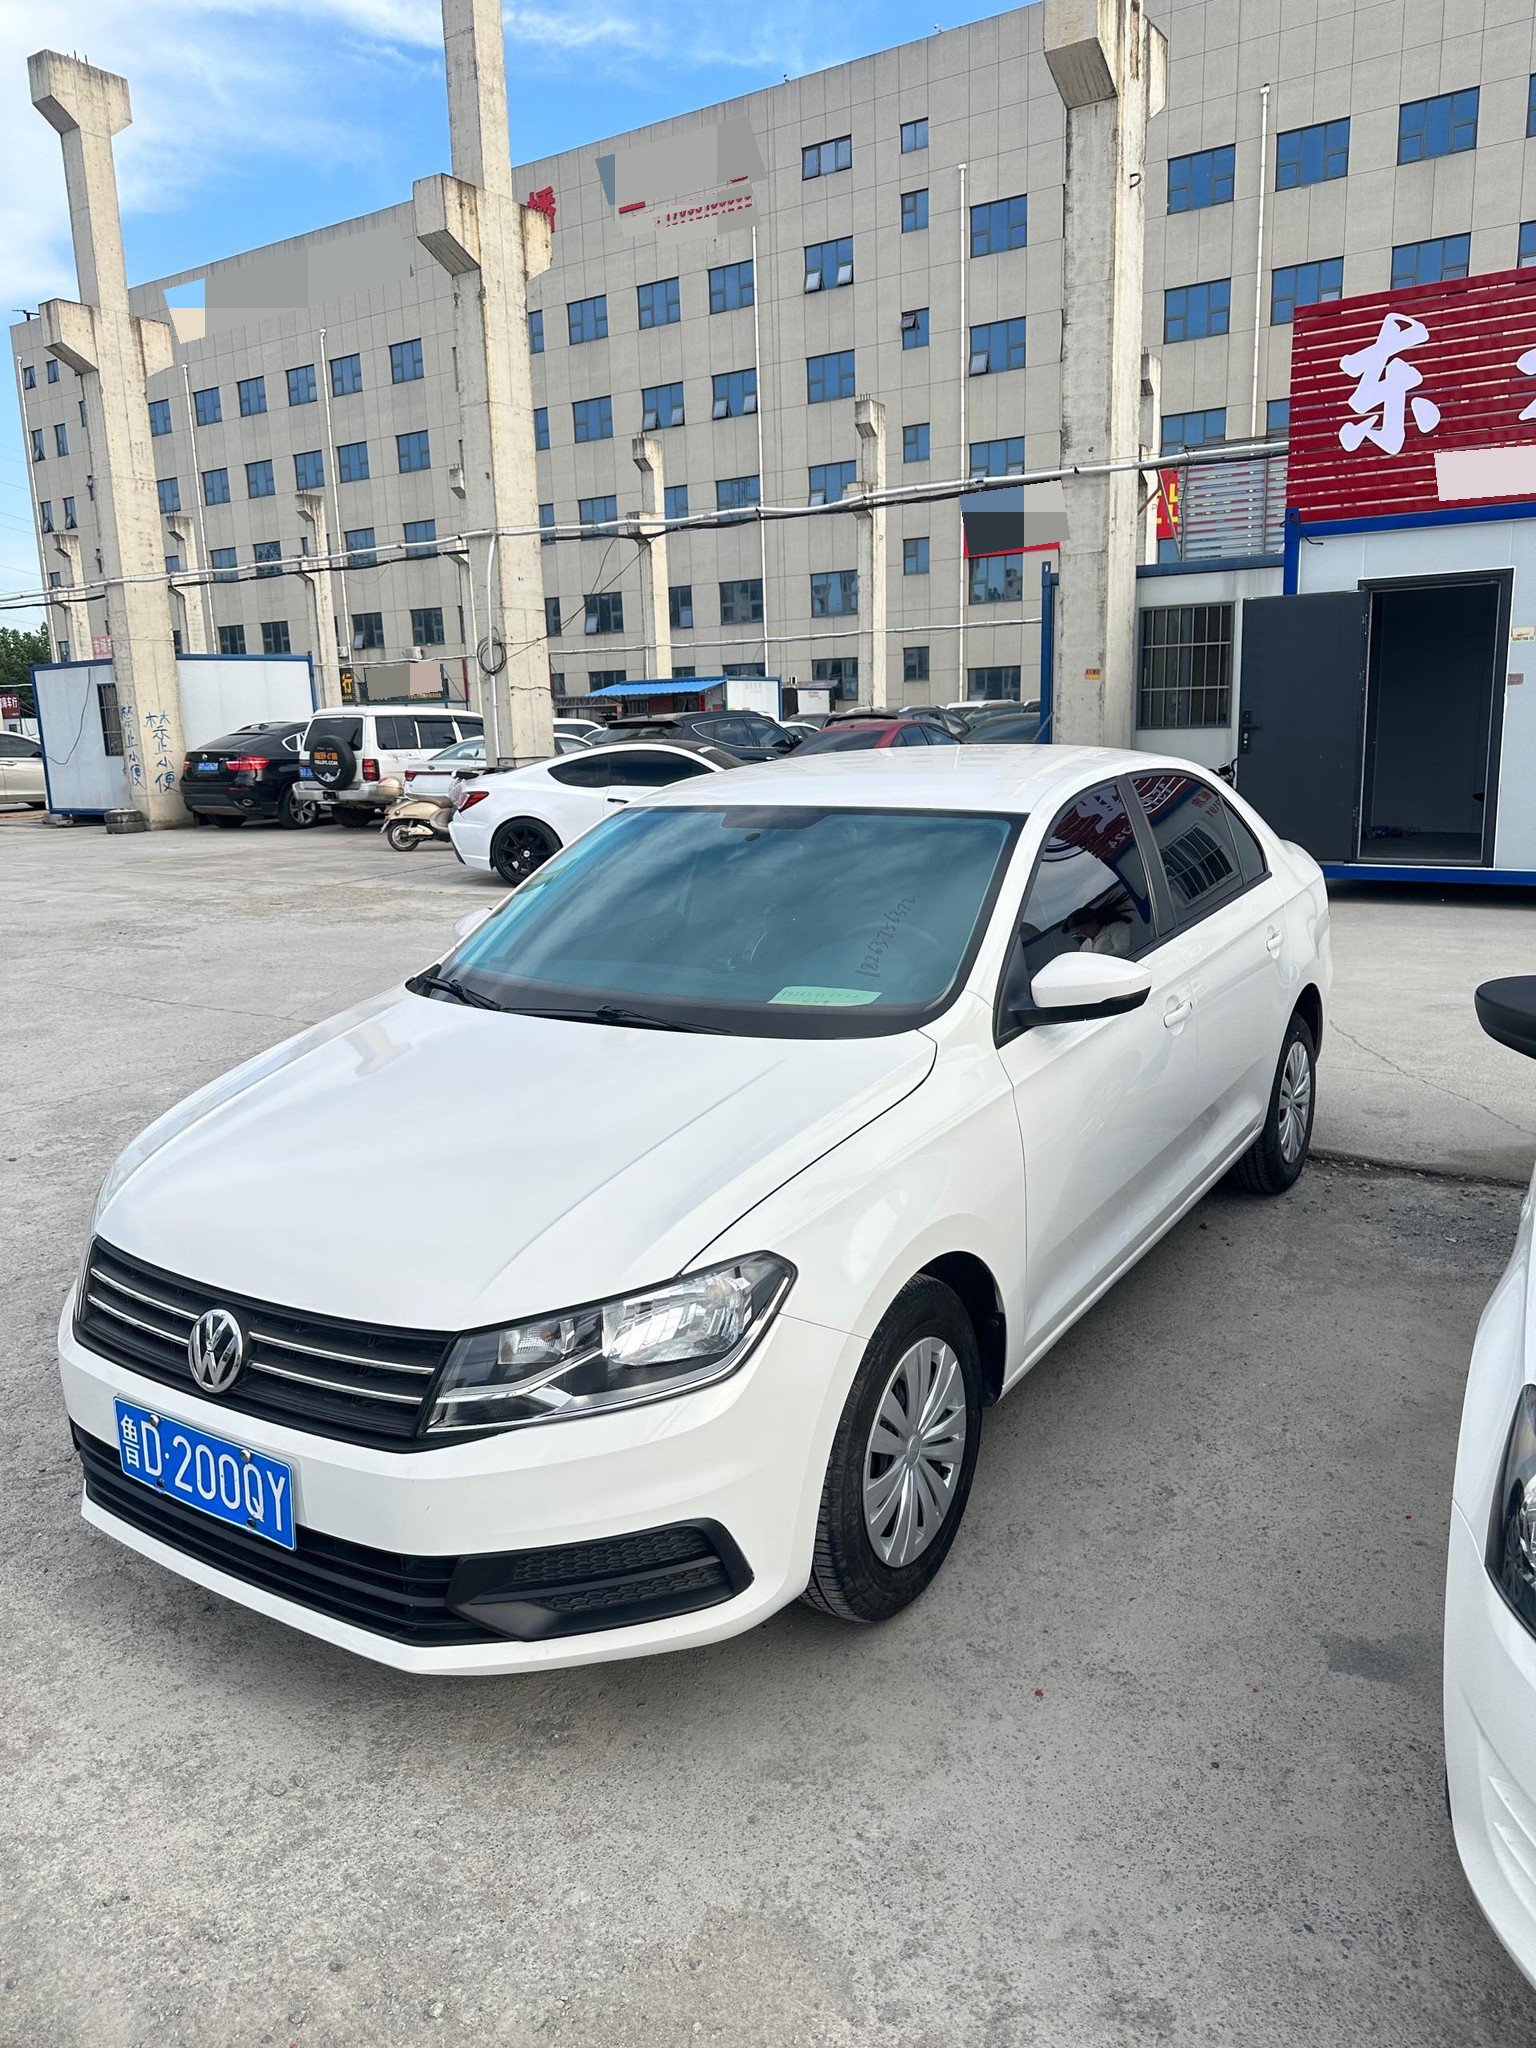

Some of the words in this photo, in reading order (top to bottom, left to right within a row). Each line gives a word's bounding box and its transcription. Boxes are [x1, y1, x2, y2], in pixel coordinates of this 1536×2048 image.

[1339, 313, 1536, 455] 东
[120, 706, 146, 790] 禁止小便
[145, 711, 180, 793] 禁止小便
[121, 1414, 286, 1532] 鲁D·200QY
